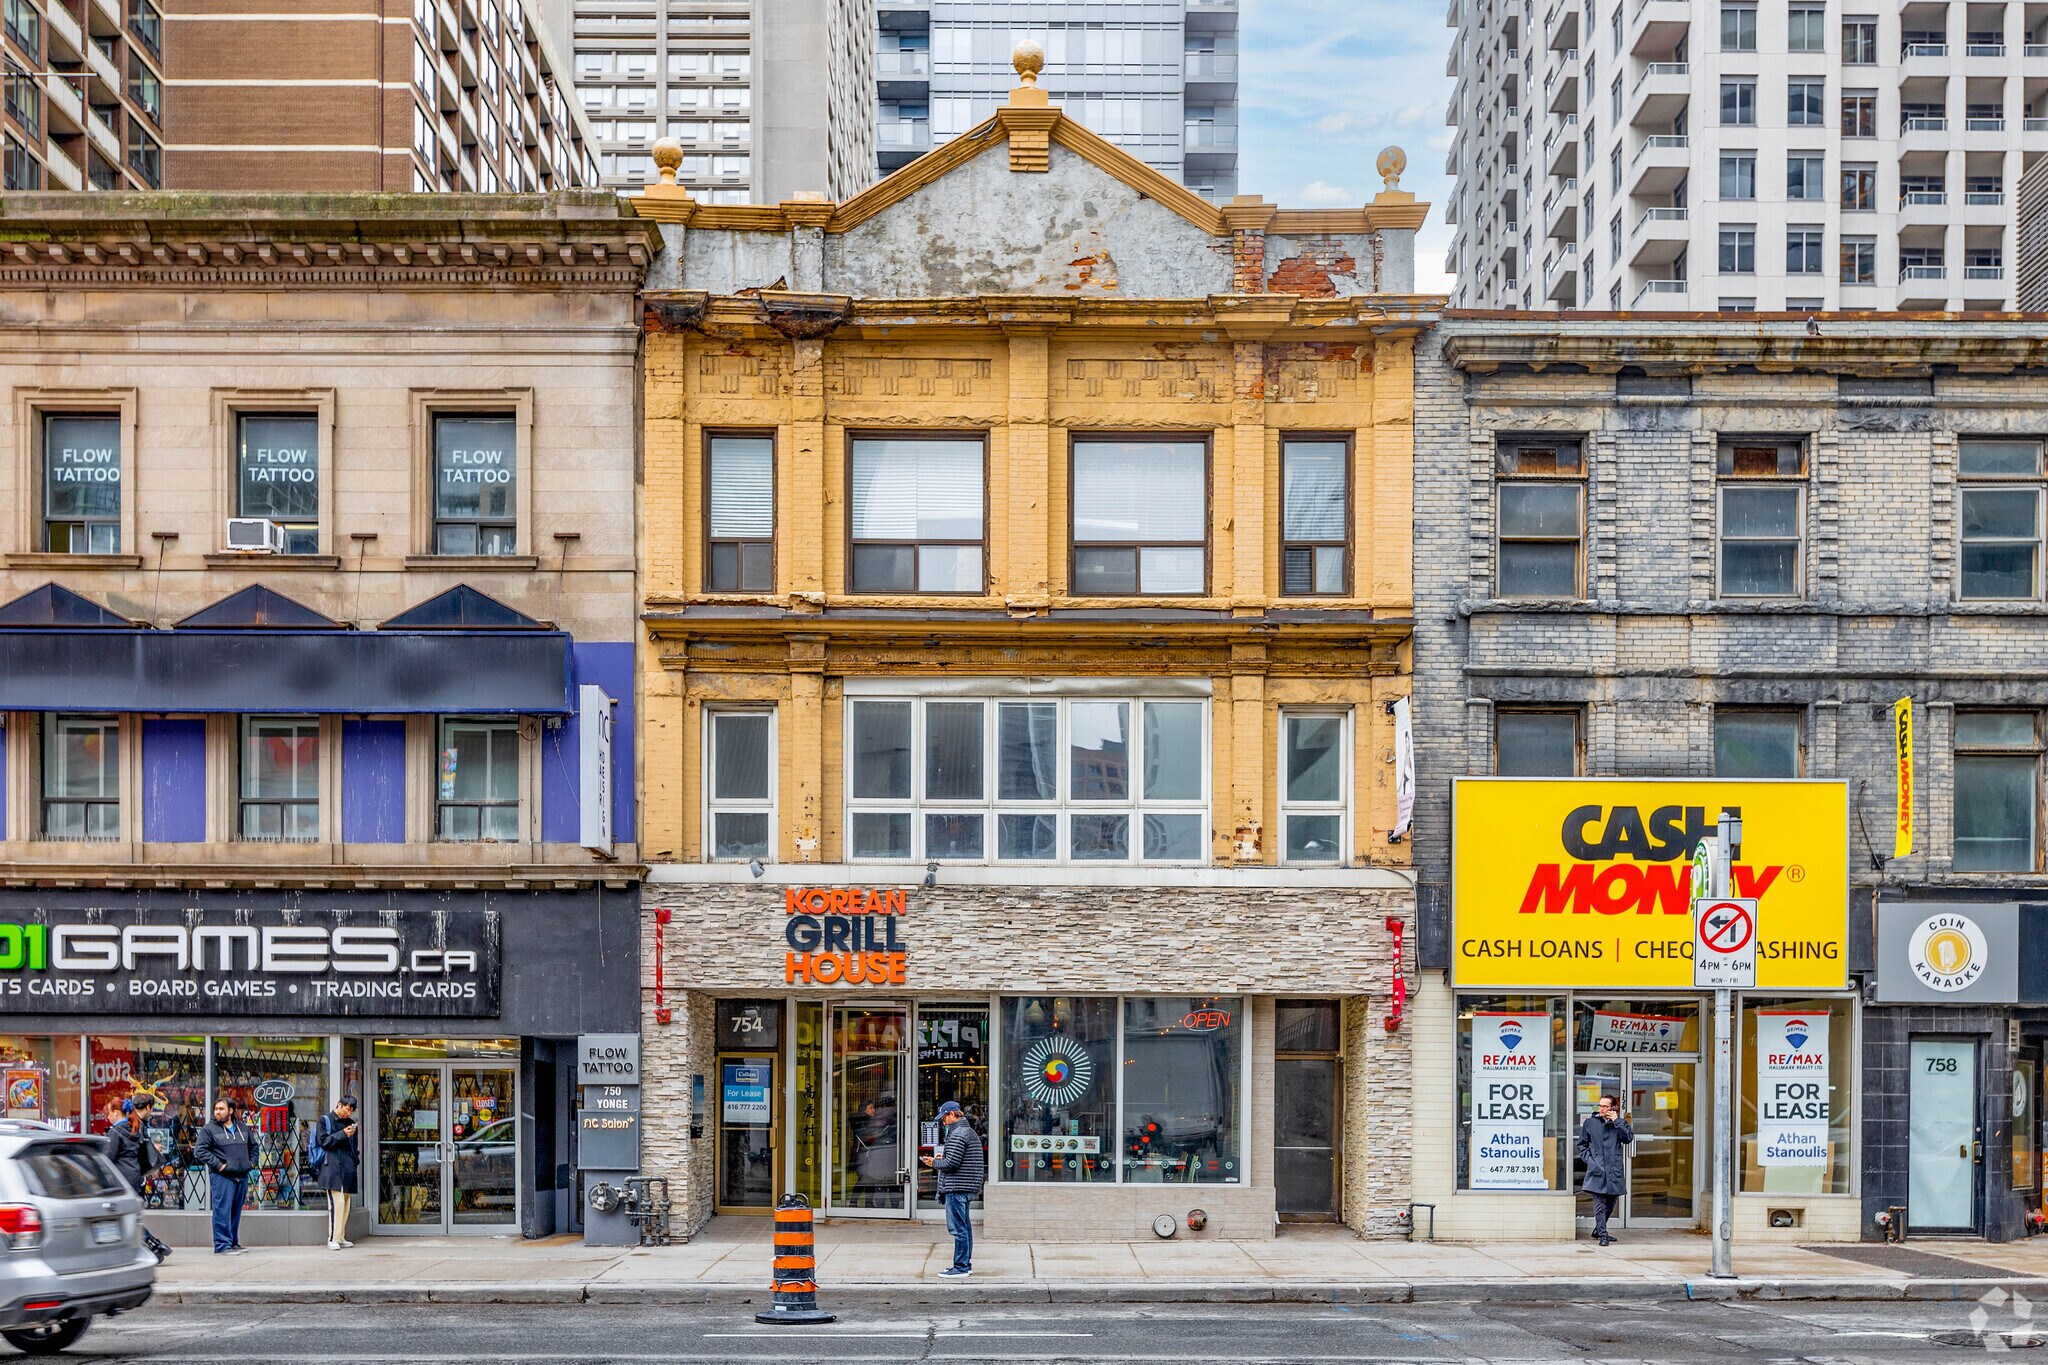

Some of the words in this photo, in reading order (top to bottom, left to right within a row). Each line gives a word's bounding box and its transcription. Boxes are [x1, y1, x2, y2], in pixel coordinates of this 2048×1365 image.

[62, 449, 113, 463] FLOW
[257, 449, 307, 463] FLOW
[452, 450, 502, 464] FLOW
[54, 468, 120, 482] TATTOO
[248, 468, 315, 482] TATTOO
[444, 469, 511, 483] TATTOO
[1518, 863, 1785, 915] MONY
[785, 888, 907, 915] KOREAN
[1928, 918, 1965, 931] COIN
[785, 915, 906, 951] GRILL
[1461, 939, 1522, 958] CASH
[1529, 940, 1603, 959] LOANS
[1635, 941, 1694, 960] CHEQ
[1756, 941, 1838, 960] ASHING
[785, 951, 907, 984] HOUSE
[1699, 959, 1720, 971] 4PM
[1731, 959, 1751, 971] 6PM
[1915, 962, 1981, 988] KARAOKE
[28, 979, 95, 996] CARDS
[129, 980, 197, 996] BOARD
[204, 980, 276, 997] GAMES
[311, 981, 402, 998] TRADING
[410, 981, 477, 998] CARDS
[731, 1017, 764, 1032] 754
[1183, 1011, 1231, 1028] OPEN
[1610, 1019, 1657, 1032] RE/MAX
[1593, 1038, 1628, 1052] FOR
[589, 1048, 627, 1059] FLOW
[1483, 1055, 1537, 1066] RE/MAX
[1769, 1054, 1823, 1065] RE/MAX
[582, 1062, 634, 1074] TATTOO
[1926, 1058, 1957, 1072] 758
[256, 1086, 291, 1100] OPEN
[603, 1086, 622, 1096] 750
[741, 1089, 762, 1097] Lease
[1489, 1084, 1534, 1100] FOR
[1775, 1083, 1820, 1100] FOR
[475, 1099, 495, 1108] CLOSED
[596, 1099, 628, 1109] YONGE
[1477, 1103, 1545, 1120] LEASE
[1763, 1103, 1829, 1119] LEASE
[601, 1117, 629, 1129] Salon
[1490, 1133, 1530, 1145] Athan
[1777, 1133, 1817, 1144] Athan
[1480, 1147, 1541, 1159] Stanoulis
[1766, 1146, 1827, 1158] Stanoulis
